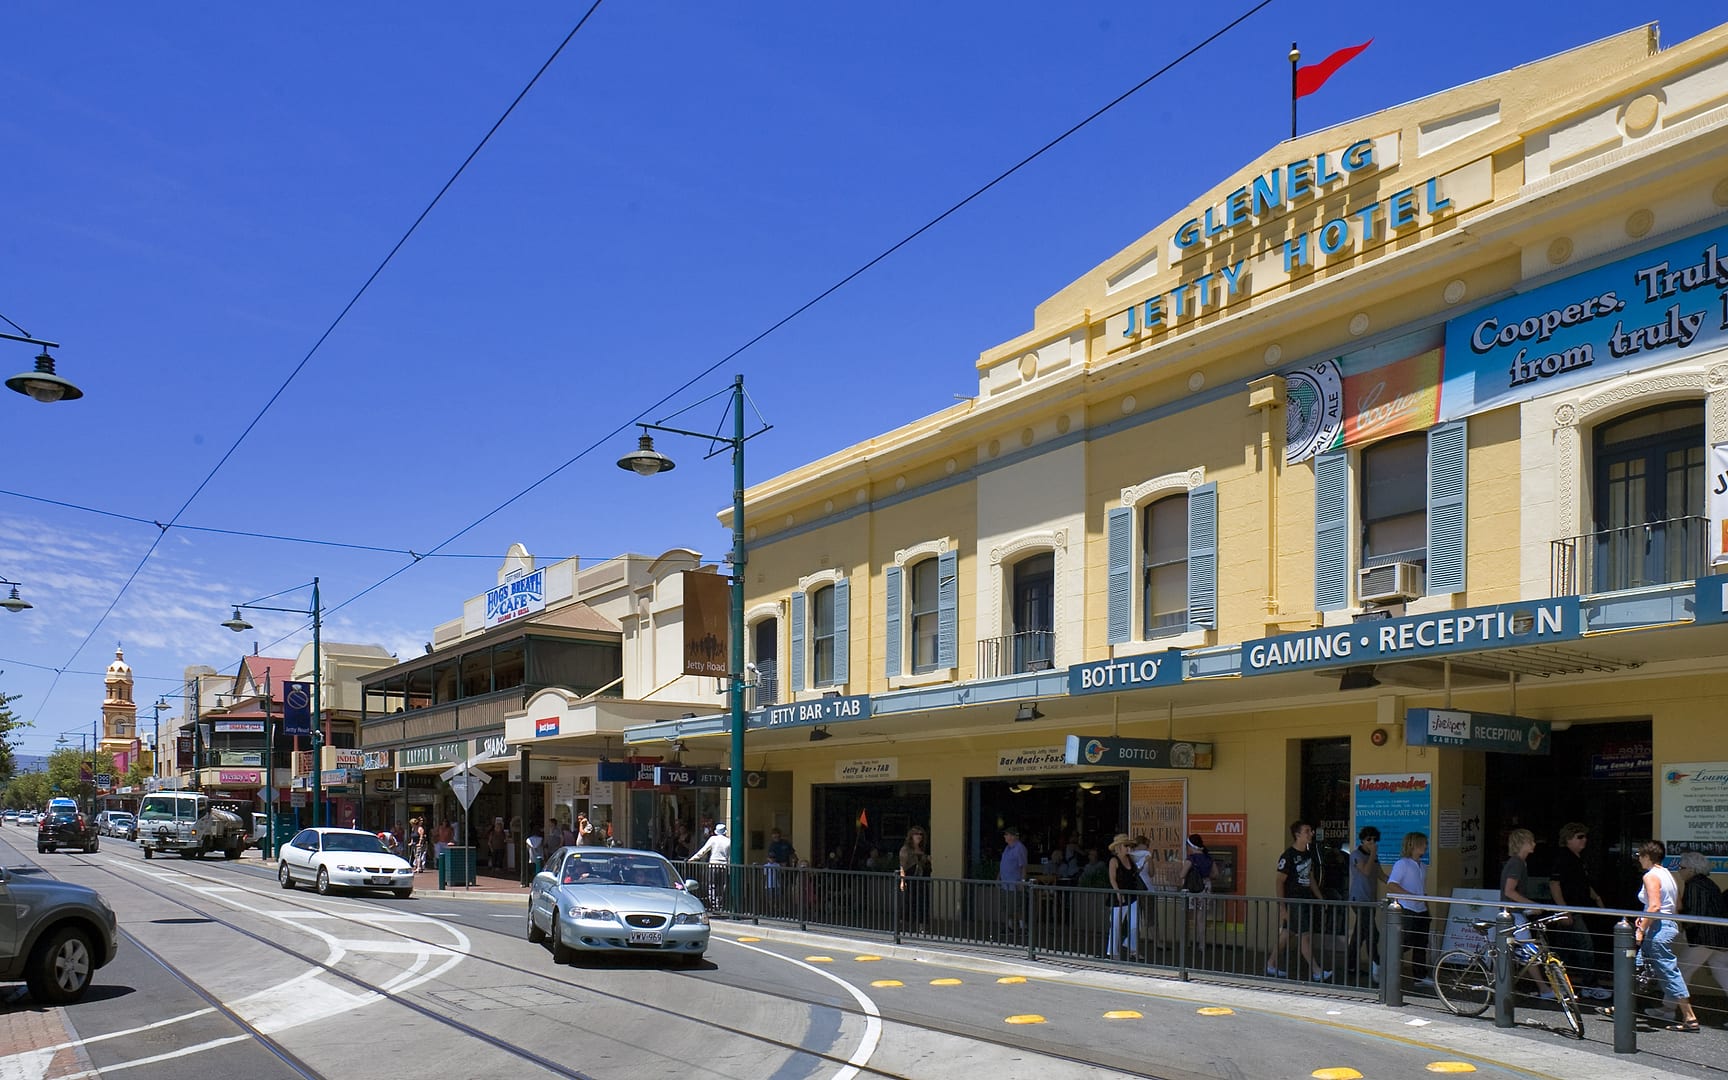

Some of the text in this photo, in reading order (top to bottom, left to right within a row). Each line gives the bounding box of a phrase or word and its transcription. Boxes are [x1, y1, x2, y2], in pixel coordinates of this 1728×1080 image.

[1173, 138, 1378, 250] GLENELG
[1122, 176, 1451, 339] JETTY HOTEL
[1470, 289, 1625, 354] Coopers.
[1509, 302, 1707, 388] from truly
[1311, 391, 1339, 455] PALE ALE
[511, 572, 542, 596] BREATH
[1249, 631, 1352, 669] GAMING
[687, 660, 726, 672] Jetty Road
[1081, 659, 1162, 690] BOTTLO'
[769, 699, 861, 726] JETTY BAR TAB
[1474, 726, 1522, 742] RECEPTION
[842, 764, 890, 774] Jetty Bar TAB
[1000, 753, 1066, 766] Bar Meals FoxS
[667, 772, 688, 782] TAB
[701, 774, 722, 782] JETTY
[1215, 822, 1240, 833] ATM
